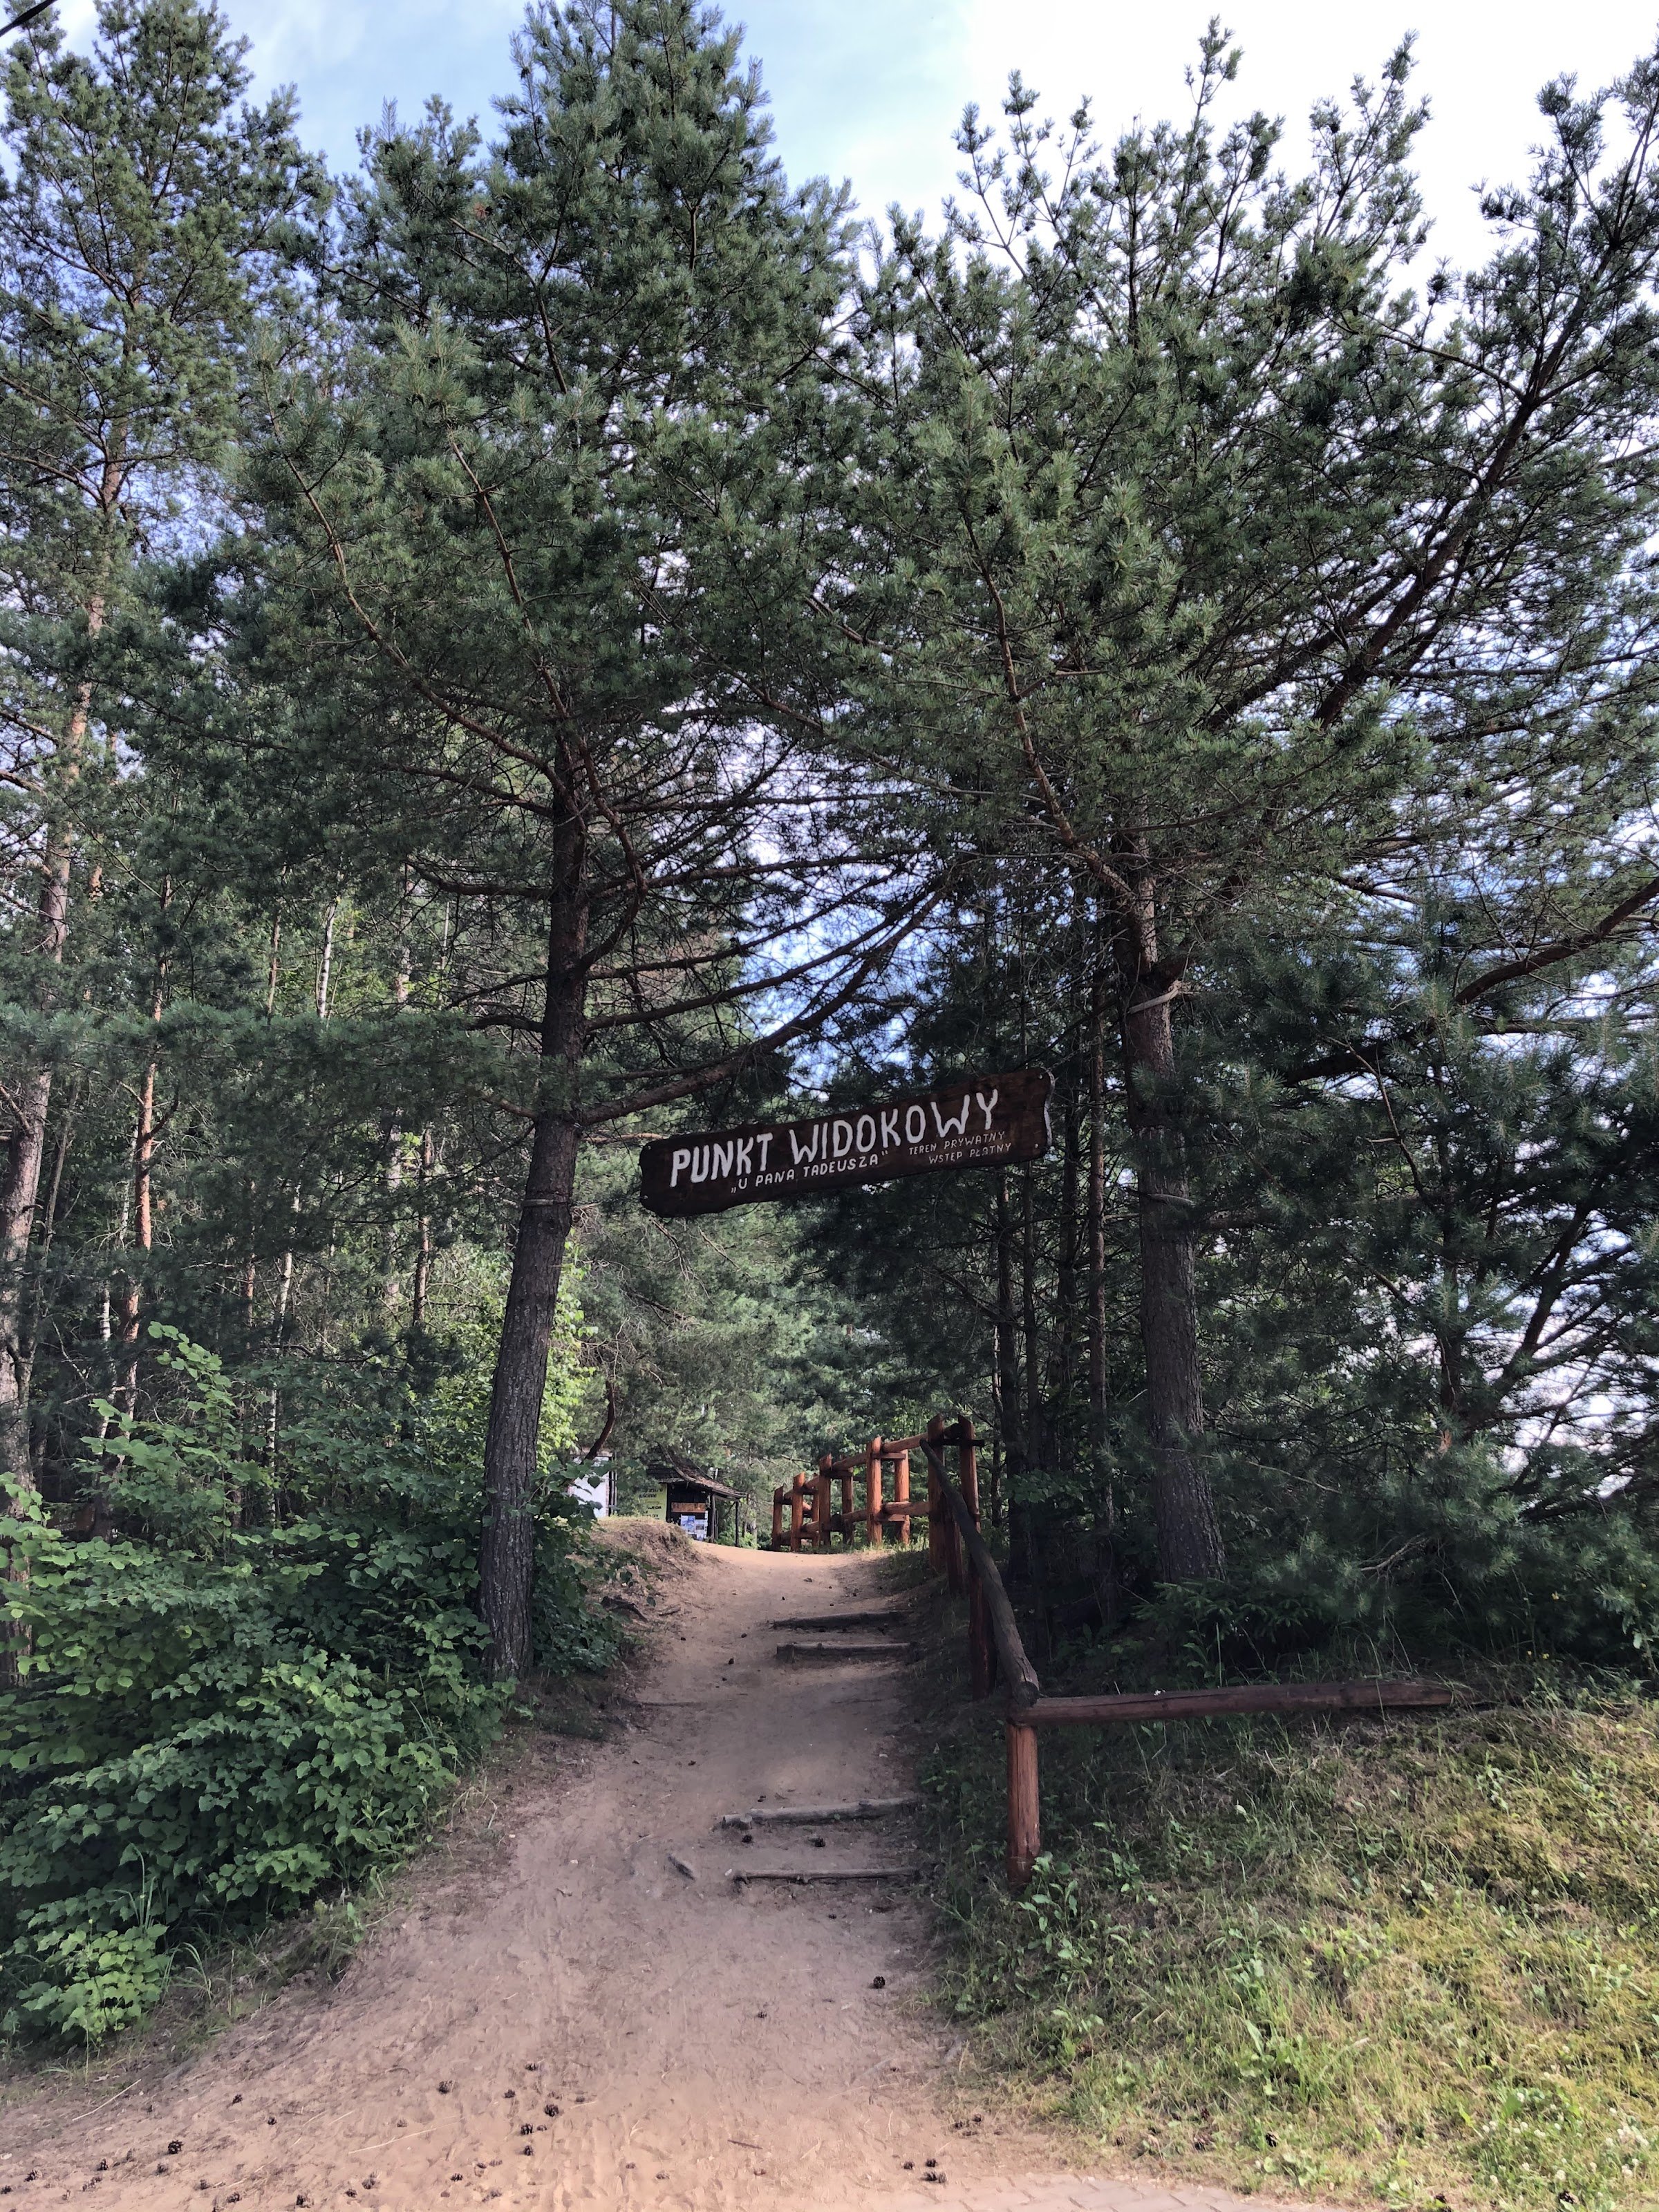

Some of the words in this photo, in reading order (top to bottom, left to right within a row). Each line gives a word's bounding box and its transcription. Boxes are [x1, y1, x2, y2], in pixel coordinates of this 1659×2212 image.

[669, 1132, 773, 1188] PUNKT
[789, 1089, 998, 1165] WIDOKOWY
[909, 1143, 937, 1155] TEREN
[944, 1131, 1005, 1149] PRYWATNY
[928, 1151, 963, 1164] WSTĘP
[969, 1143, 1011, 1157] PŁATNY
[755, 1169, 795, 1187] PANA
